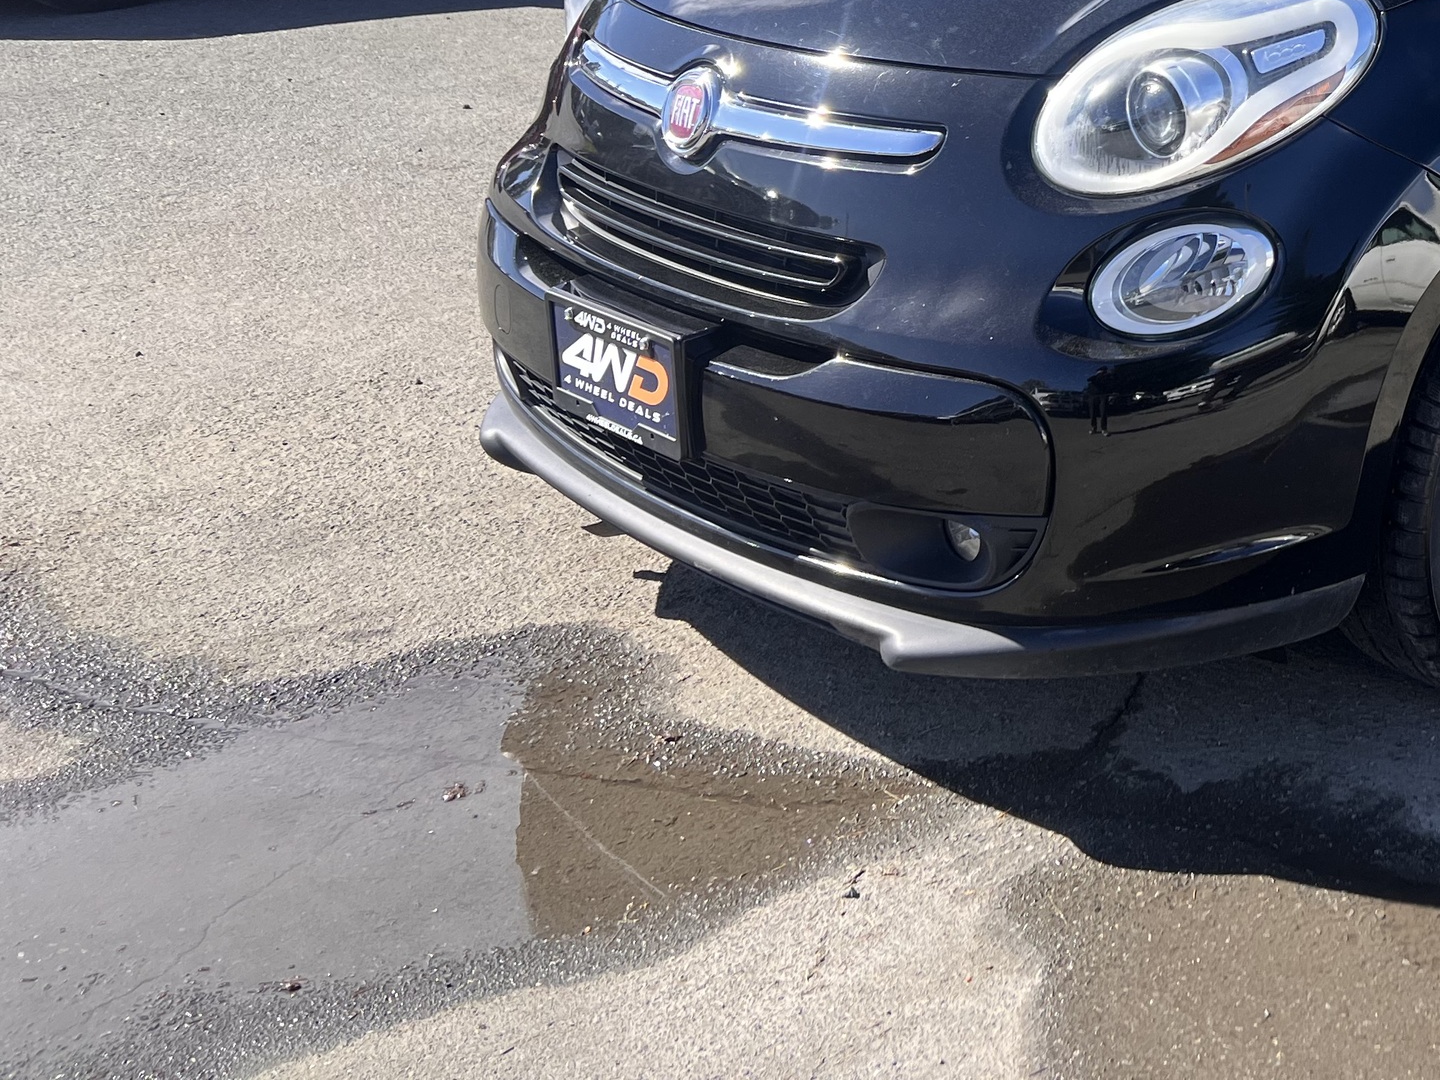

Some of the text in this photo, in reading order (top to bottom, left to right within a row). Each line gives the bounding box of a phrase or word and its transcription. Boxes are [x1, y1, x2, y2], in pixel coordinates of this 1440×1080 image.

[671, 94, 700, 130] FIAT
[606, 322, 641, 341] 4 WHEEL
[611, 331, 638, 348] DEALS
[561, 332, 669, 406] 4WD
[563, 374, 661, 423] 4 WHEEL DEALS
